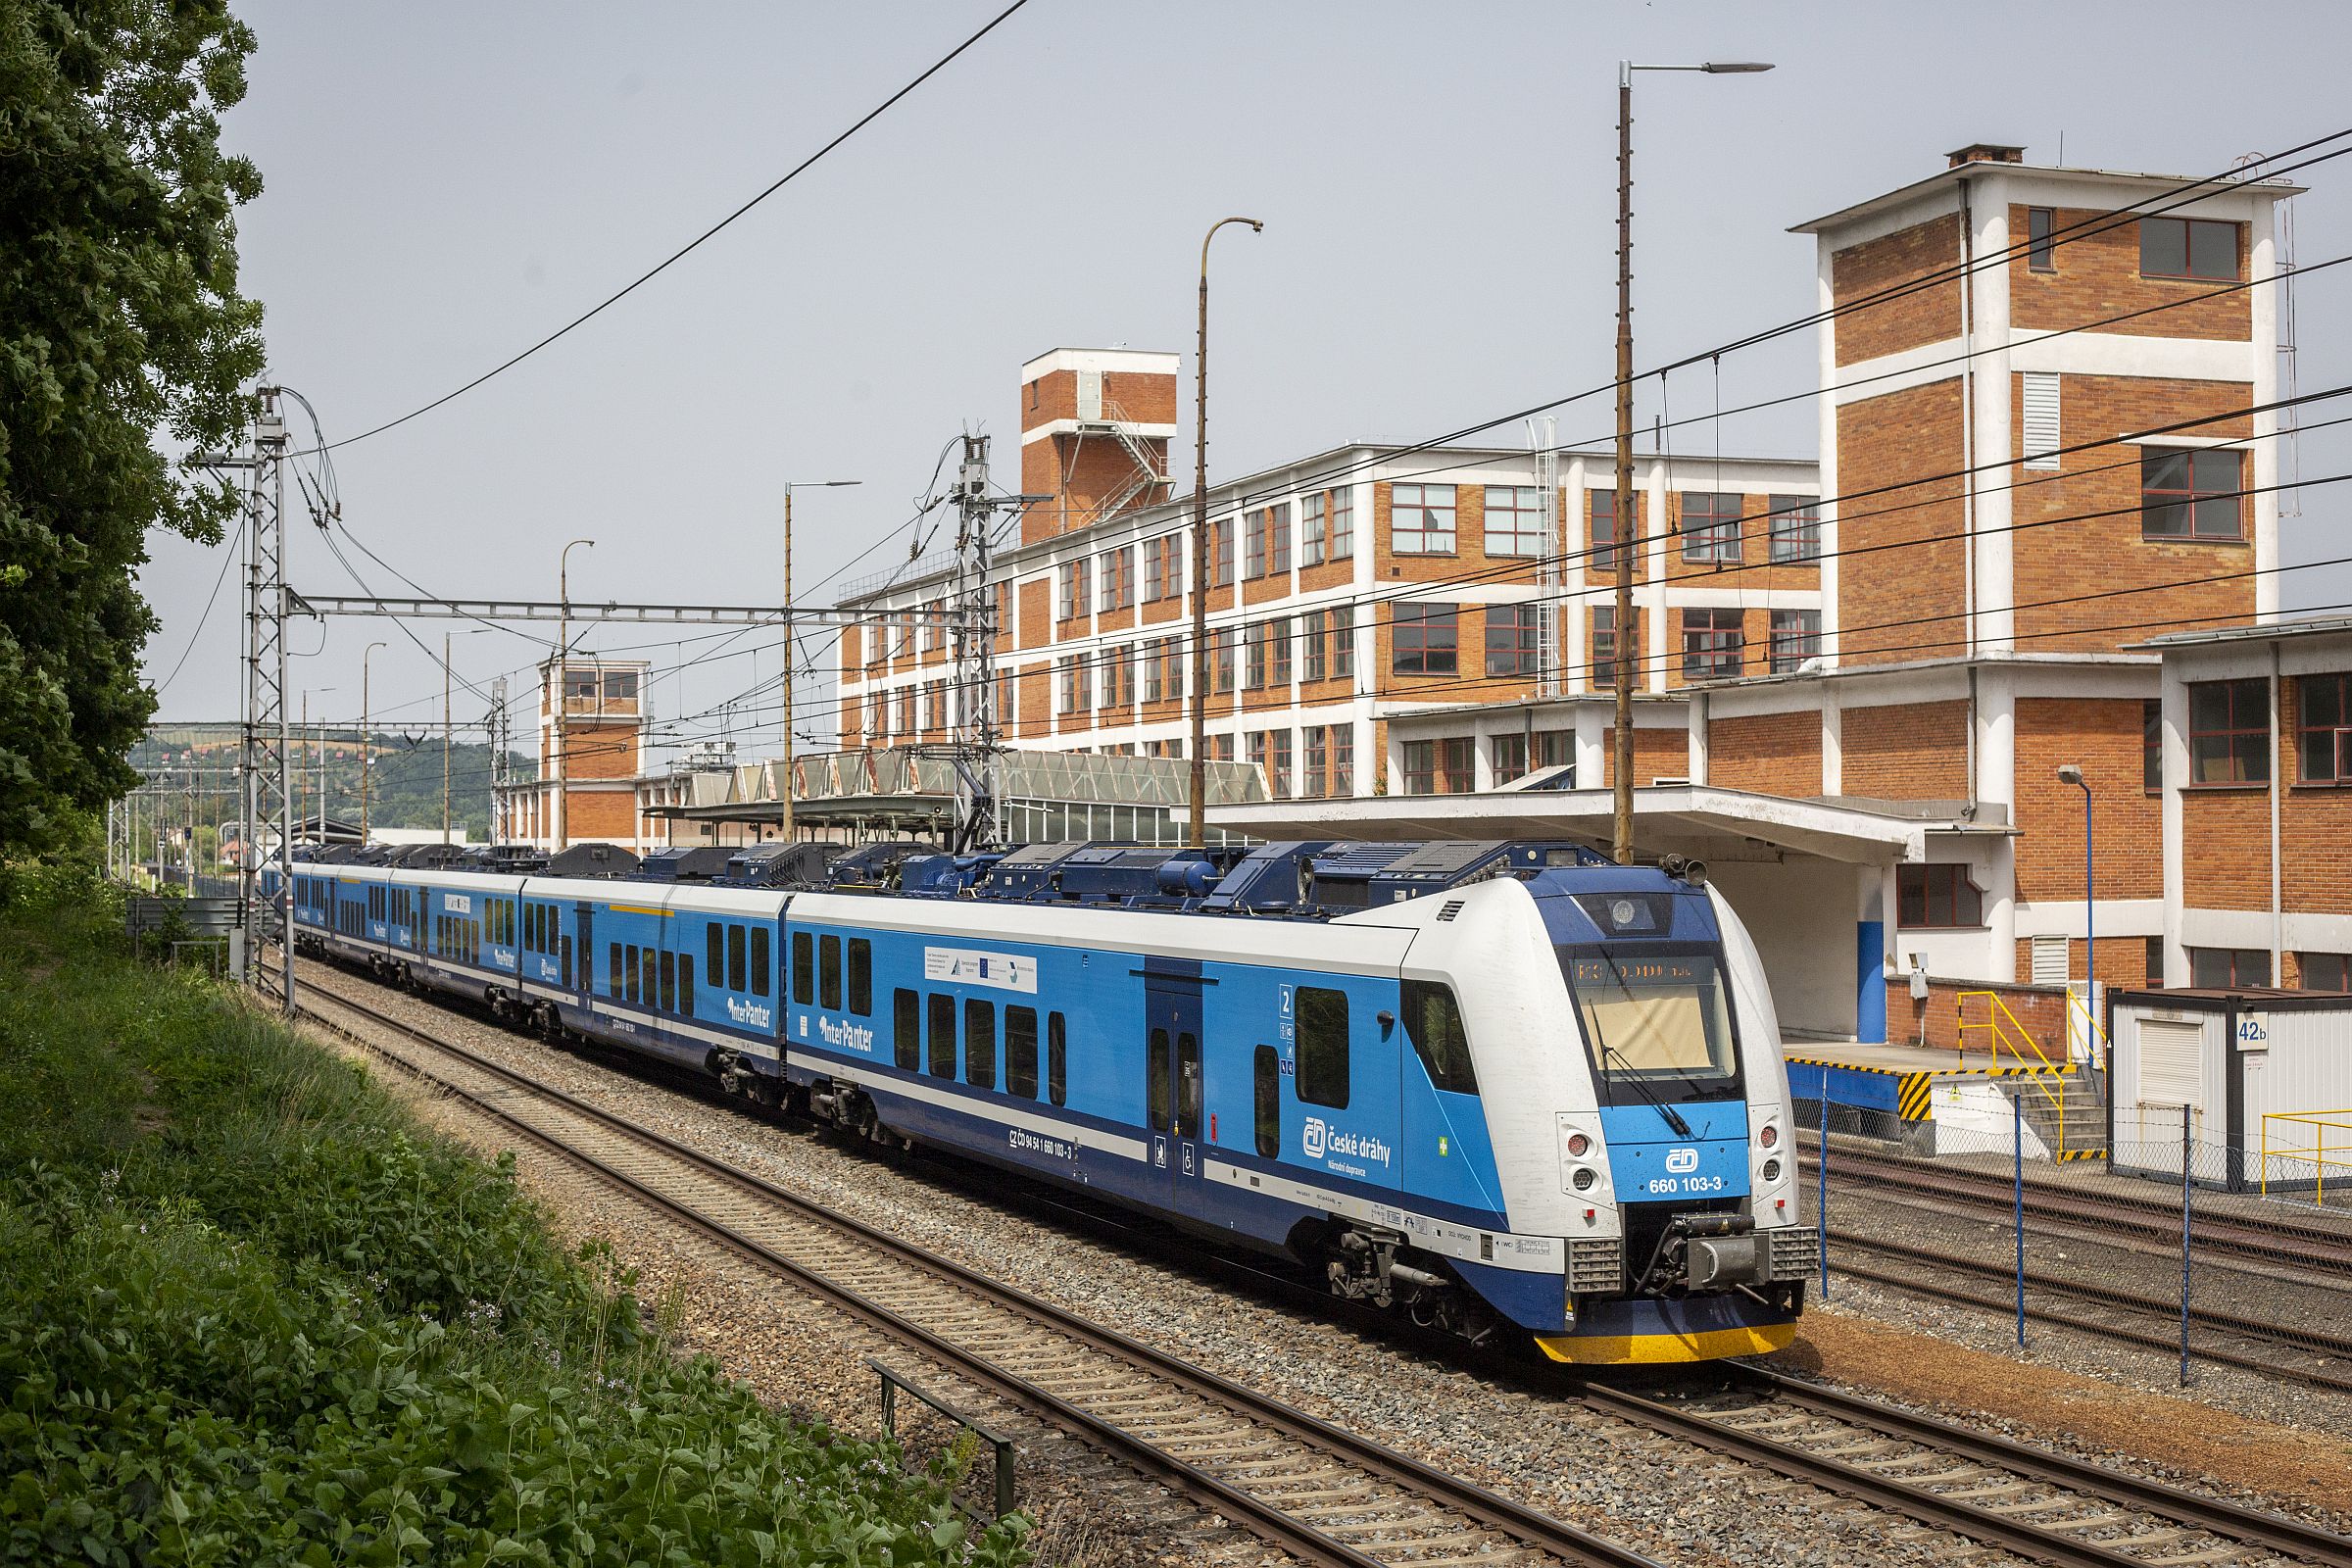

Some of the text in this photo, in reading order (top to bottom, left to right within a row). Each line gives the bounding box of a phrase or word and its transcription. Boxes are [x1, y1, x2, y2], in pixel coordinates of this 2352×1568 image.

[727, 997, 770, 1029] InterPanter
[1283, 991, 1290, 1013] 2
[819, 1015, 873, 1053] InterPanter
[2239, 1022, 2267, 1040] 42b
[1009, 1130, 1017, 1145] CZ
[1026, 1135, 1032, 1150] 94
[1033, 1138, 1039, 1151] 54
[1044, 1140, 1054, 1154] 660
[1328, 1125, 1391, 1168] České dráhy
[1649, 1176, 1722, 1194] 660 103-3
